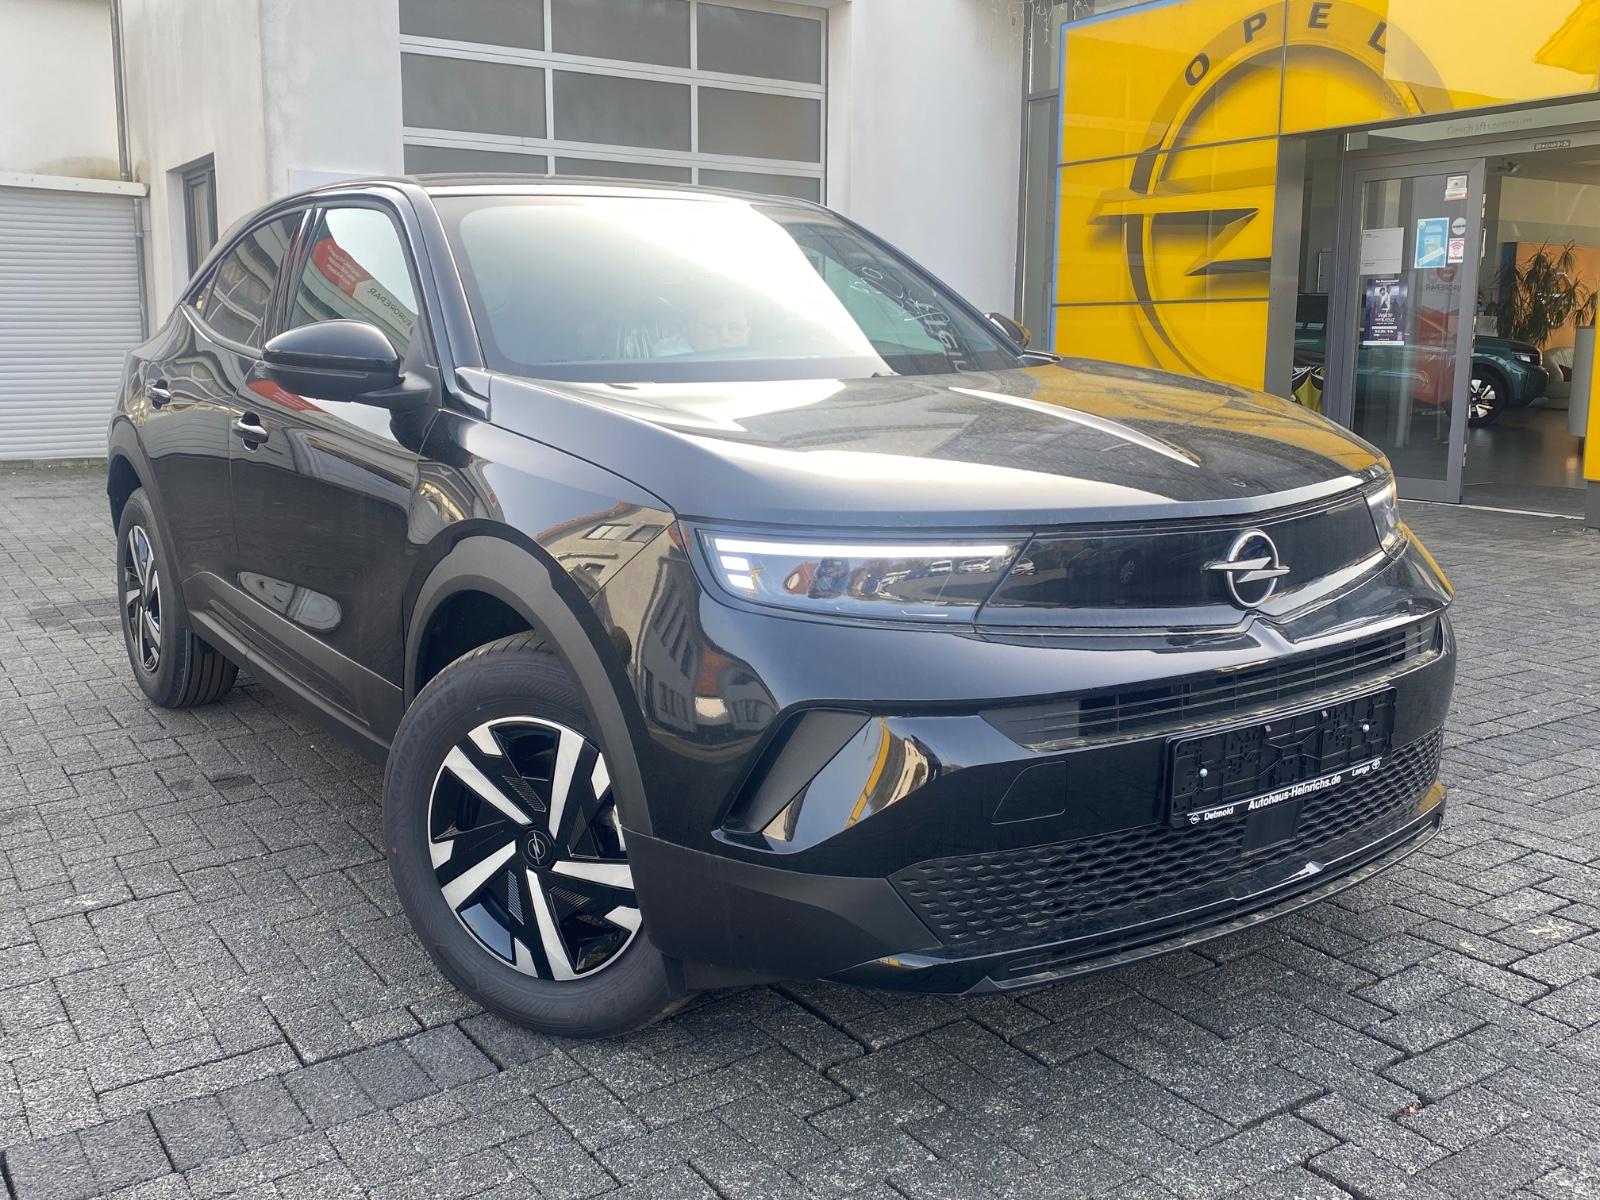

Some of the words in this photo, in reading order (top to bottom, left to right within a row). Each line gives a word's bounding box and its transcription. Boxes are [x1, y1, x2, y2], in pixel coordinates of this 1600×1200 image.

[1185, 3, 1386, 86] OPEL
[1204, 806, 1234, 821] Detmold
[1248, 774, 1341, 811] Autohaus-Heinrichs.de
[1352, 765, 1370, 777] Lemgo
